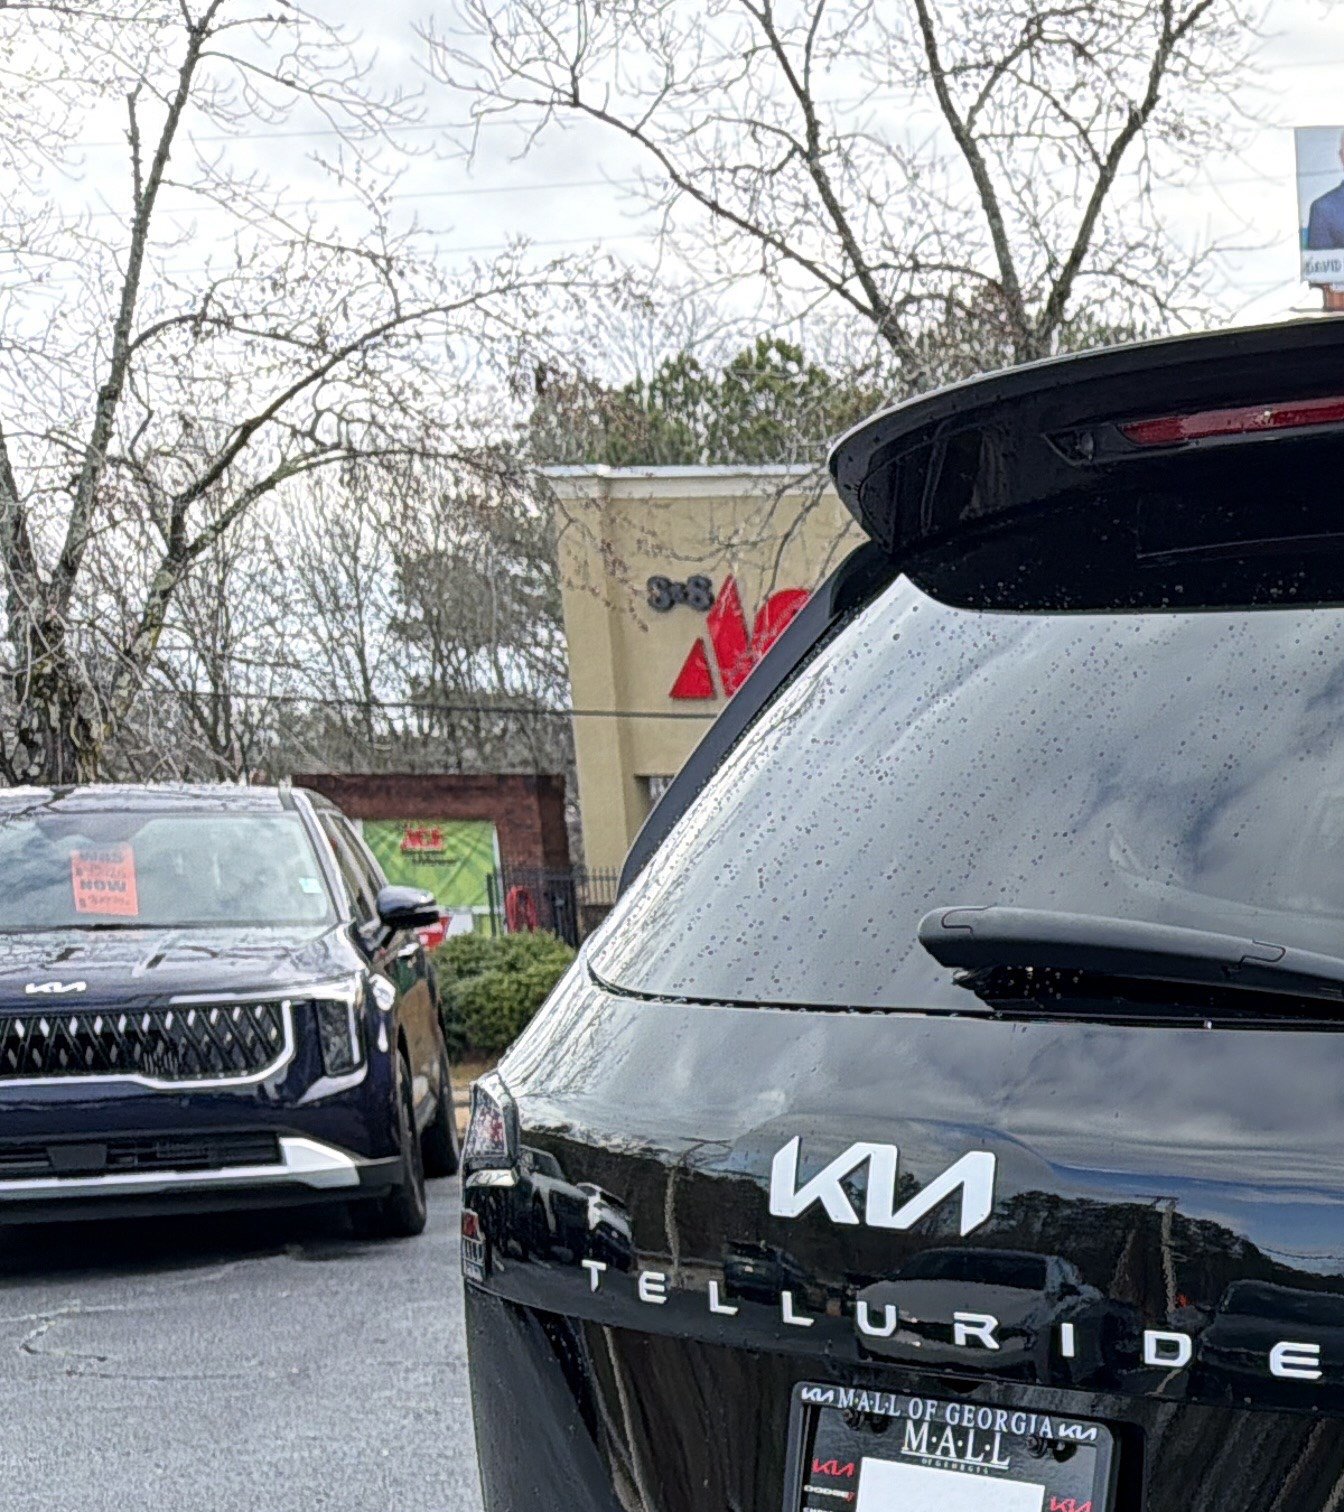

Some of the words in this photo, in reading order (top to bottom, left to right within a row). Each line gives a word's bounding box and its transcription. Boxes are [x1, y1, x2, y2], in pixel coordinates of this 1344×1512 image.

[80, 879, 126, 892] NOW
[769, 1135, 996, 1236] KIA
[581, 1259, 1323, 1380] TELLURIDE
[802, 1387, 834, 1402] KIA
[908, 1397, 938, 1421] OF
[945, 1403, 1054, 1438] GEORGIA
[1059, 1423, 1097, 1440] KIA
[812, 1458, 855, 1478] KIA
[804, 1484, 849, 1499] DODGE
